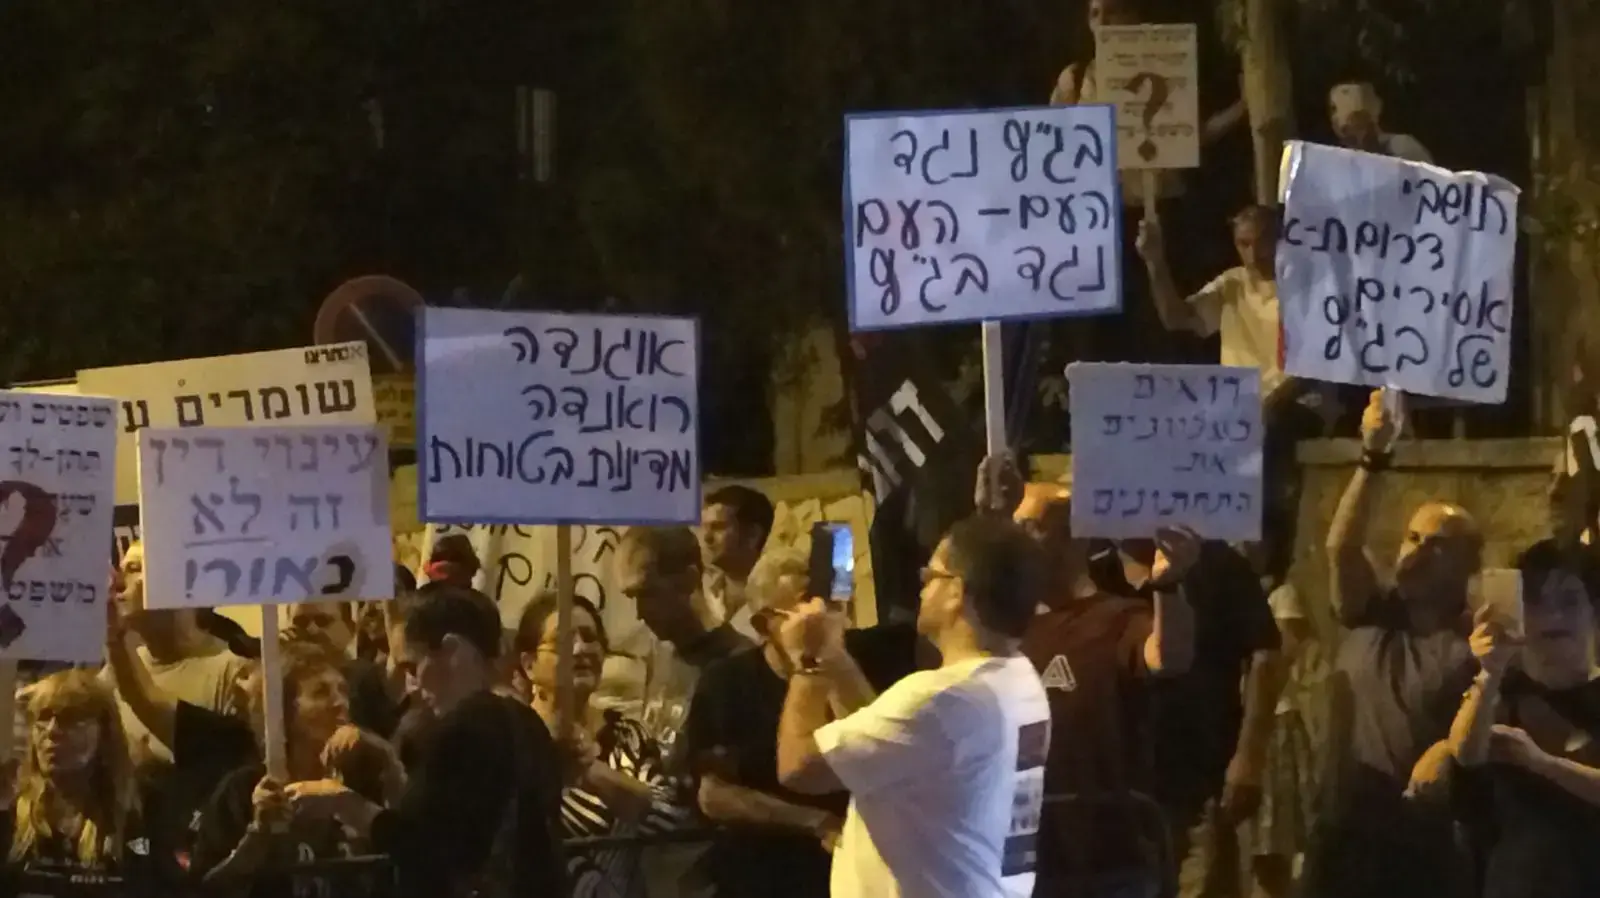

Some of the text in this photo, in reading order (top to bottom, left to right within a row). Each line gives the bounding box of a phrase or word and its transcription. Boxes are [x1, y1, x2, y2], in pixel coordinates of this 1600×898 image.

[889, 128, 978, 184] נגד
[856, 198, 959, 250] העם
[1020, 190, 1110, 235] העם
[1402, 178, 1507, 236] תושבי
[1013, 244, 1106, 301] נגד
[1355, 278, 1506, 333] אסירים
[503, 326, 685, 381] אוגנדה
[1448, 334, 1499, 388] של
[122, 400, 149, 433] ע
[174, 379, 356, 428] שומרים
[520, 383, 691, 434] רואנדה
[149, 433, 379, 484] עינוי דין
[429, 430, 691, 492] מדינות בטוחות
[190, 476, 343, 534] זה לא
